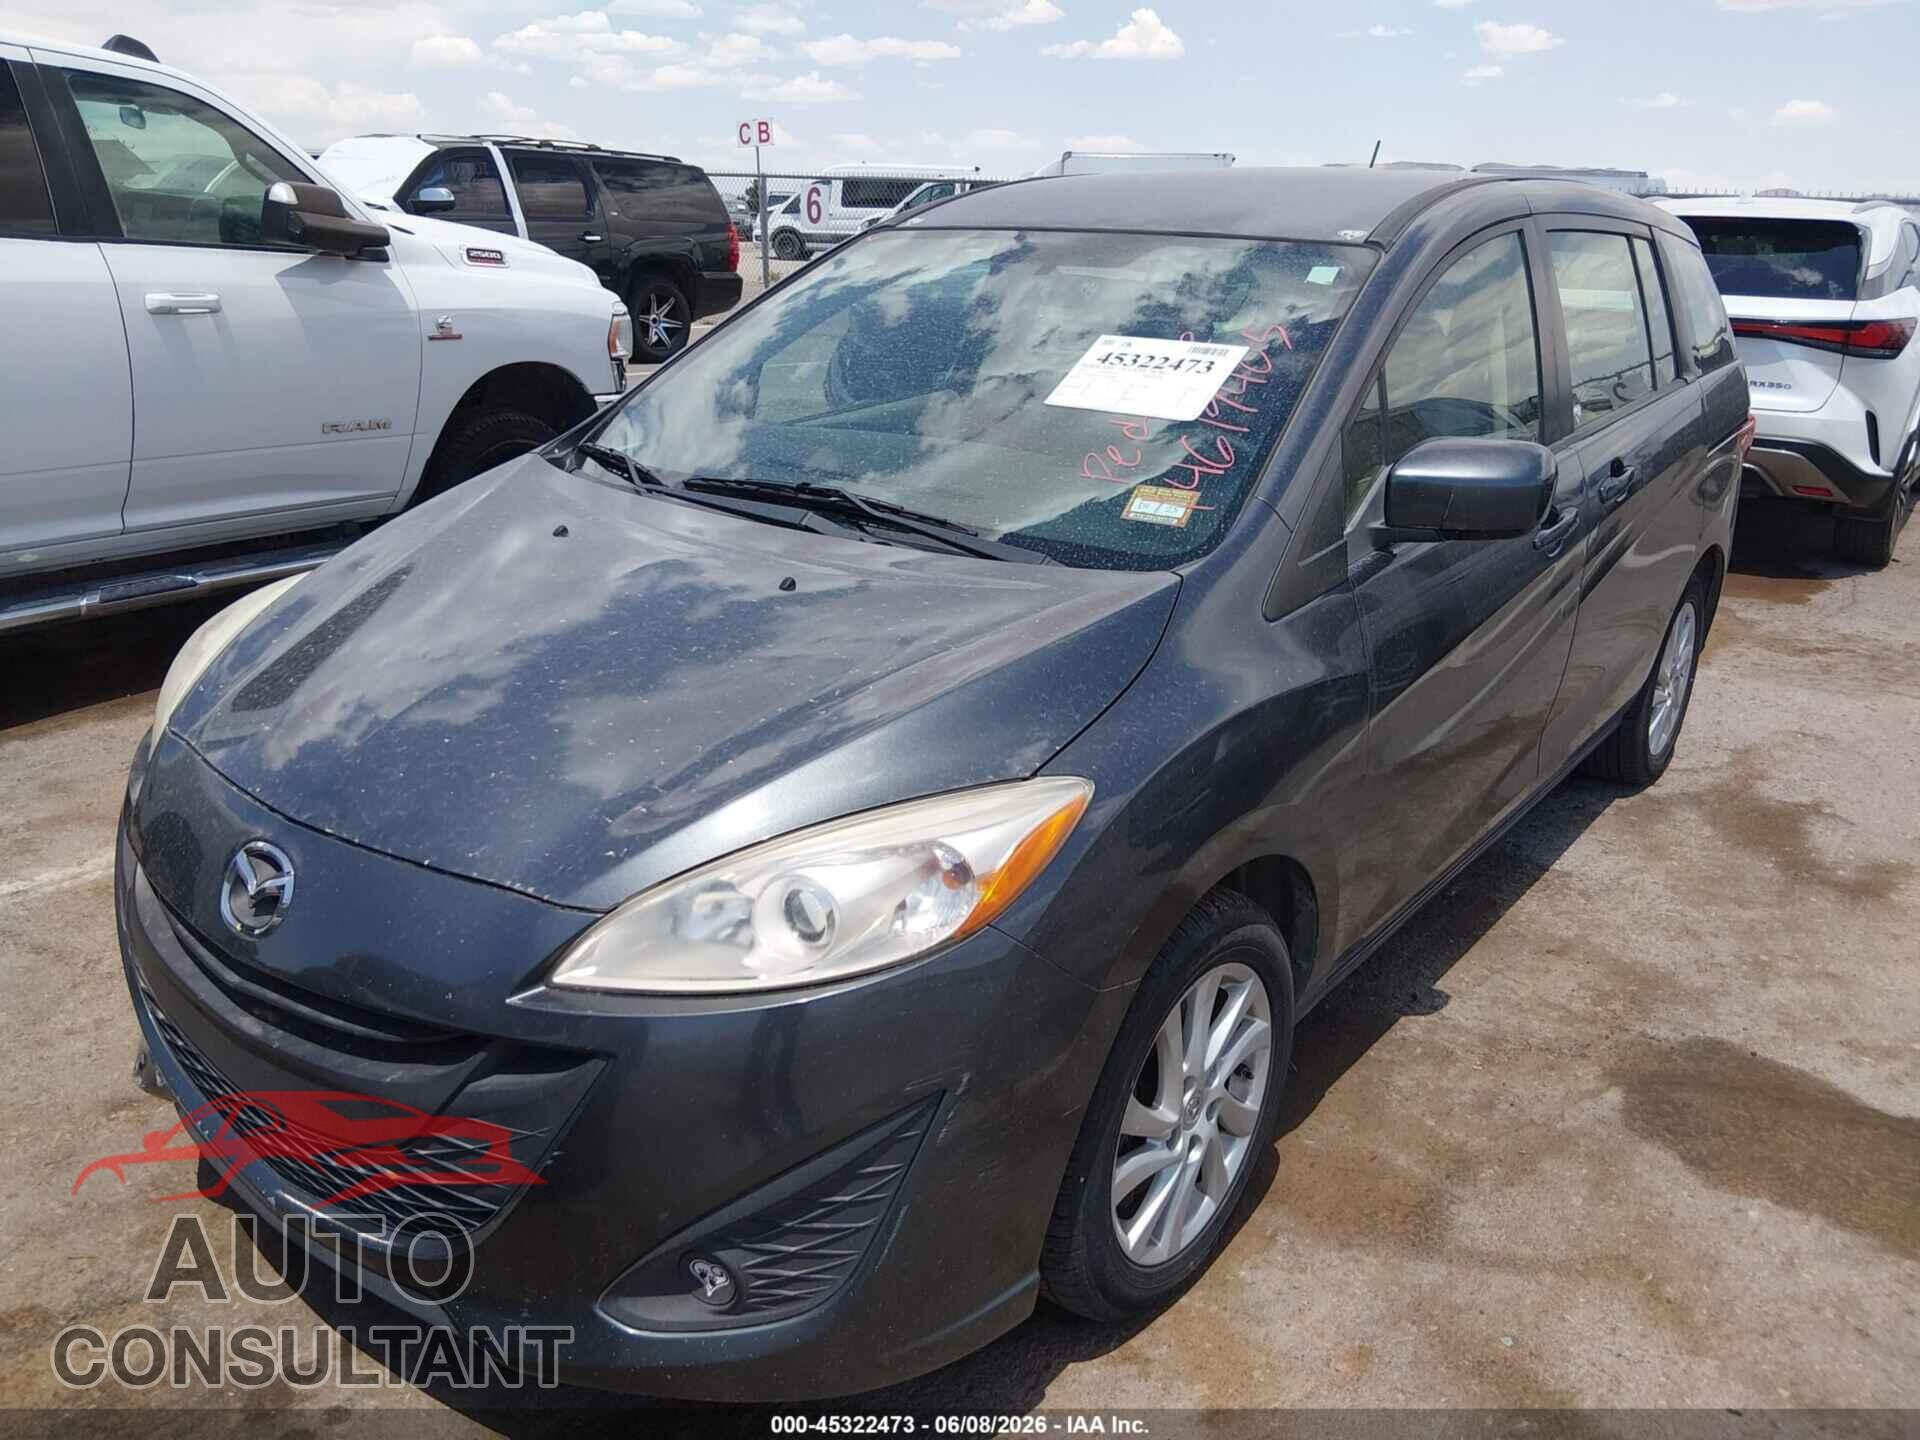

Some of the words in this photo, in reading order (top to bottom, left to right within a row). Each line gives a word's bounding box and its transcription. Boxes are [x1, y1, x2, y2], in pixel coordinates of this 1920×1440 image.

[739, 122, 752, 145] C
[757, 121, 771, 143] B
[806, 186, 822, 224] 6
[468, 250, 502, 260] 2500
[1097, 352, 1215, 374] 45322473
[320, 419, 392, 434] RAM
